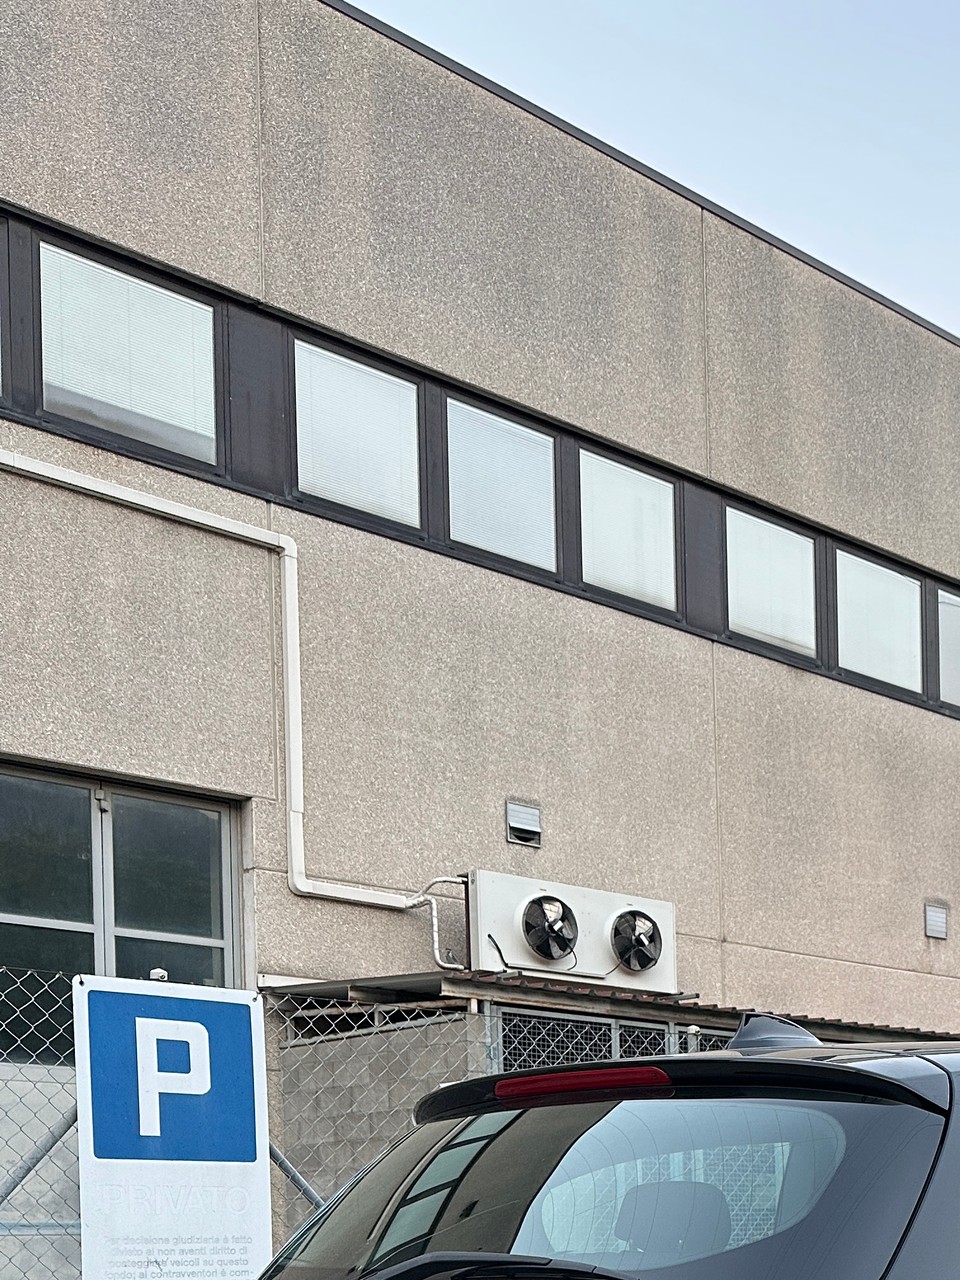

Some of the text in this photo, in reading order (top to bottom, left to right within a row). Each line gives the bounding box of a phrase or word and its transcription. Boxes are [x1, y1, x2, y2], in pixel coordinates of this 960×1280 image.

[135, 1017, 212, 1137] P
[98, 1184, 250, 1216] PRIVATO
[122, 1235, 169, 1245] decisione
[232, 1234, 252, 1244] fatto
[158, 1248, 176, 1256] non
[178, 1246, 206, 1256] aventi
[209, 1246, 236, 1255] diritto
[239, 1245, 248, 1255] di
[169, 1257, 200, 1267] veicoli
[216, 1257, 249, 1267] questo
[150, 1269, 217, 1279] contravventori
